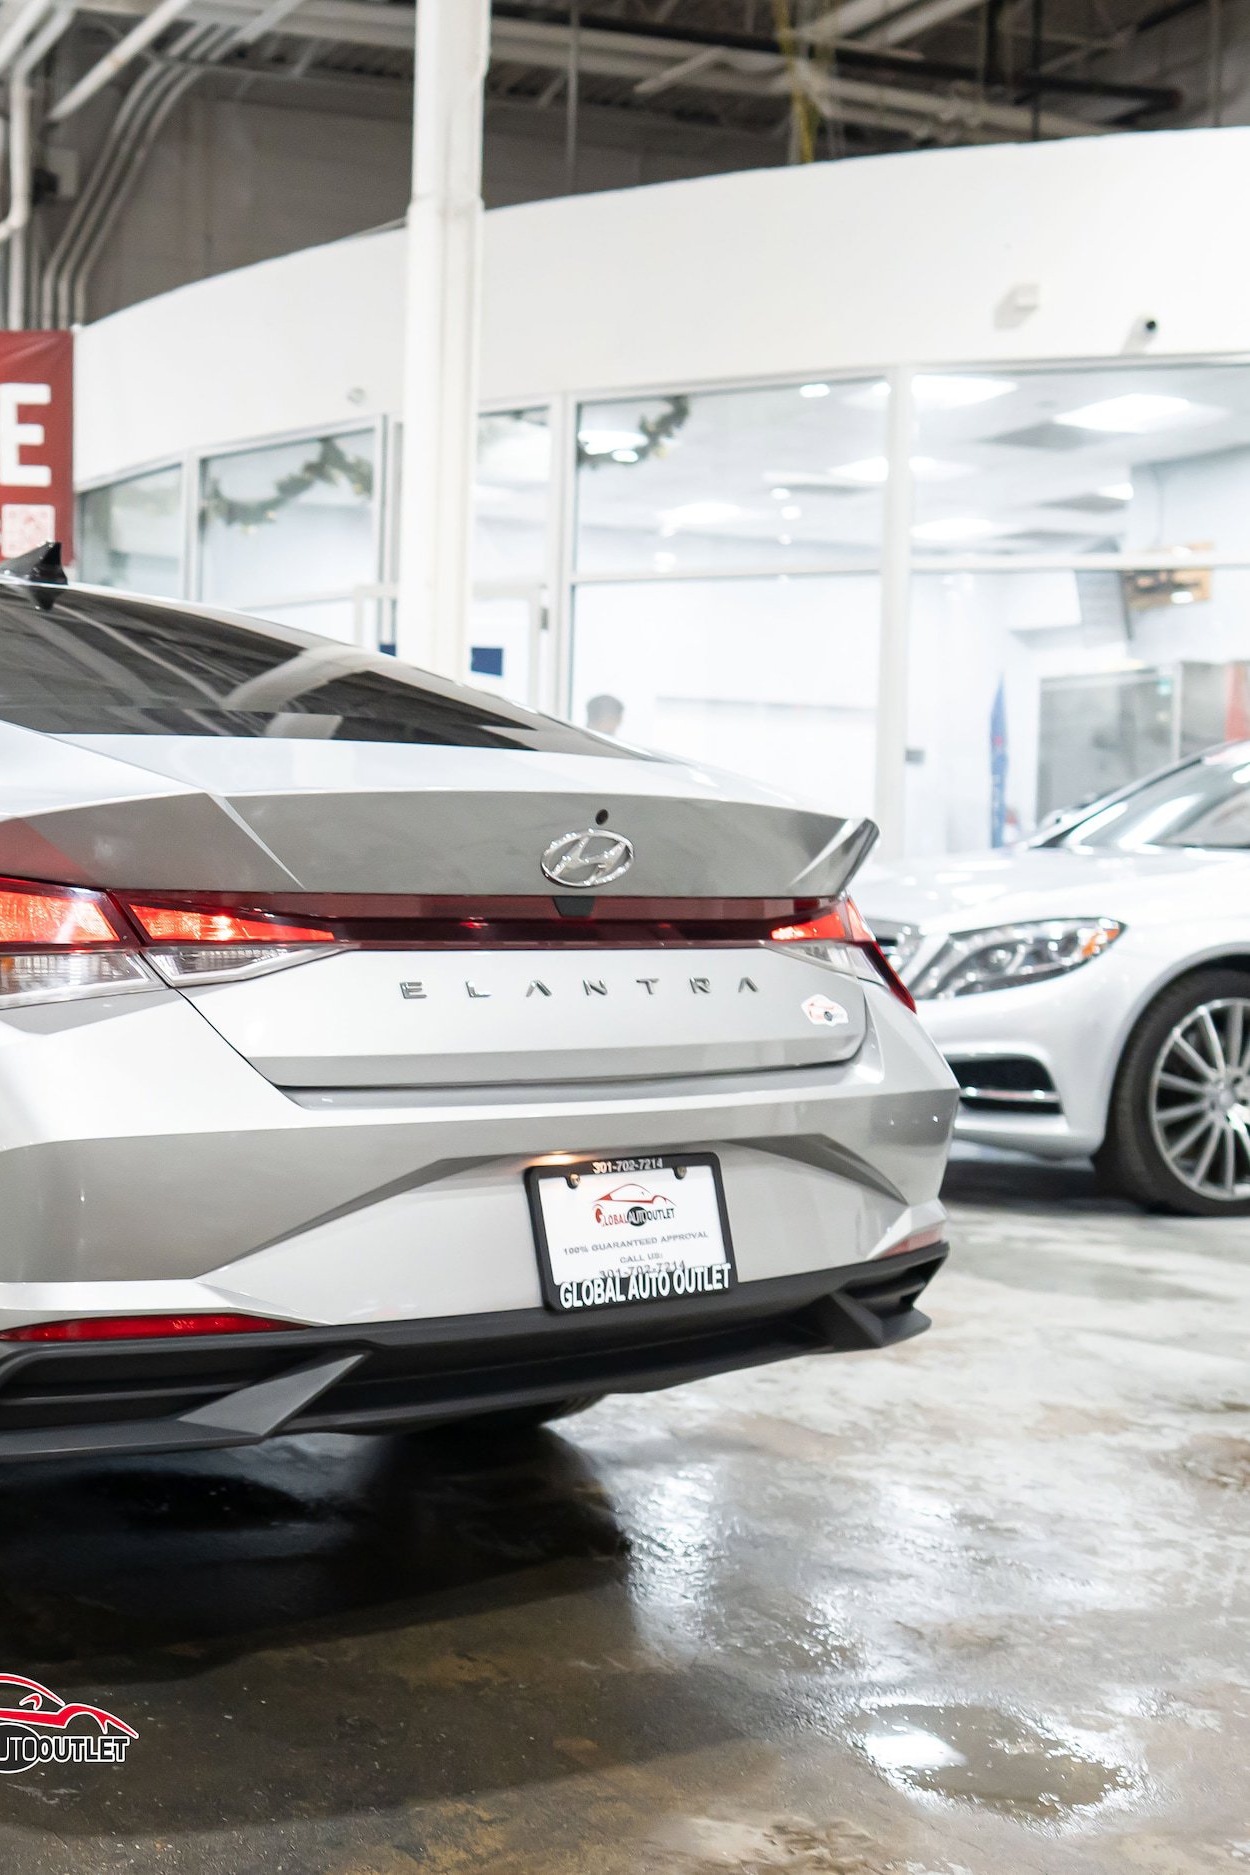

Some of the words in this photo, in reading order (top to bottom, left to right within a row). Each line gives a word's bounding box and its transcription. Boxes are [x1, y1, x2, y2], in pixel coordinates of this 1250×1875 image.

[399, 977, 759, 1000] ELANTRA
[592, 1157, 664, 1175] 301-702-7214
[563, 1245, 589, 1256] 100%
[591, 1236, 658, 1253] GUARANTEED
[660, 1231, 709, 1244] APPROVAL
[619, 1253, 646, 1264] CALL
[559, 1276, 627, 1309] GLOBAL
[627, 1270, 670, 1301] AUTO
[673, 1263, 732, 1296] OUTLET
